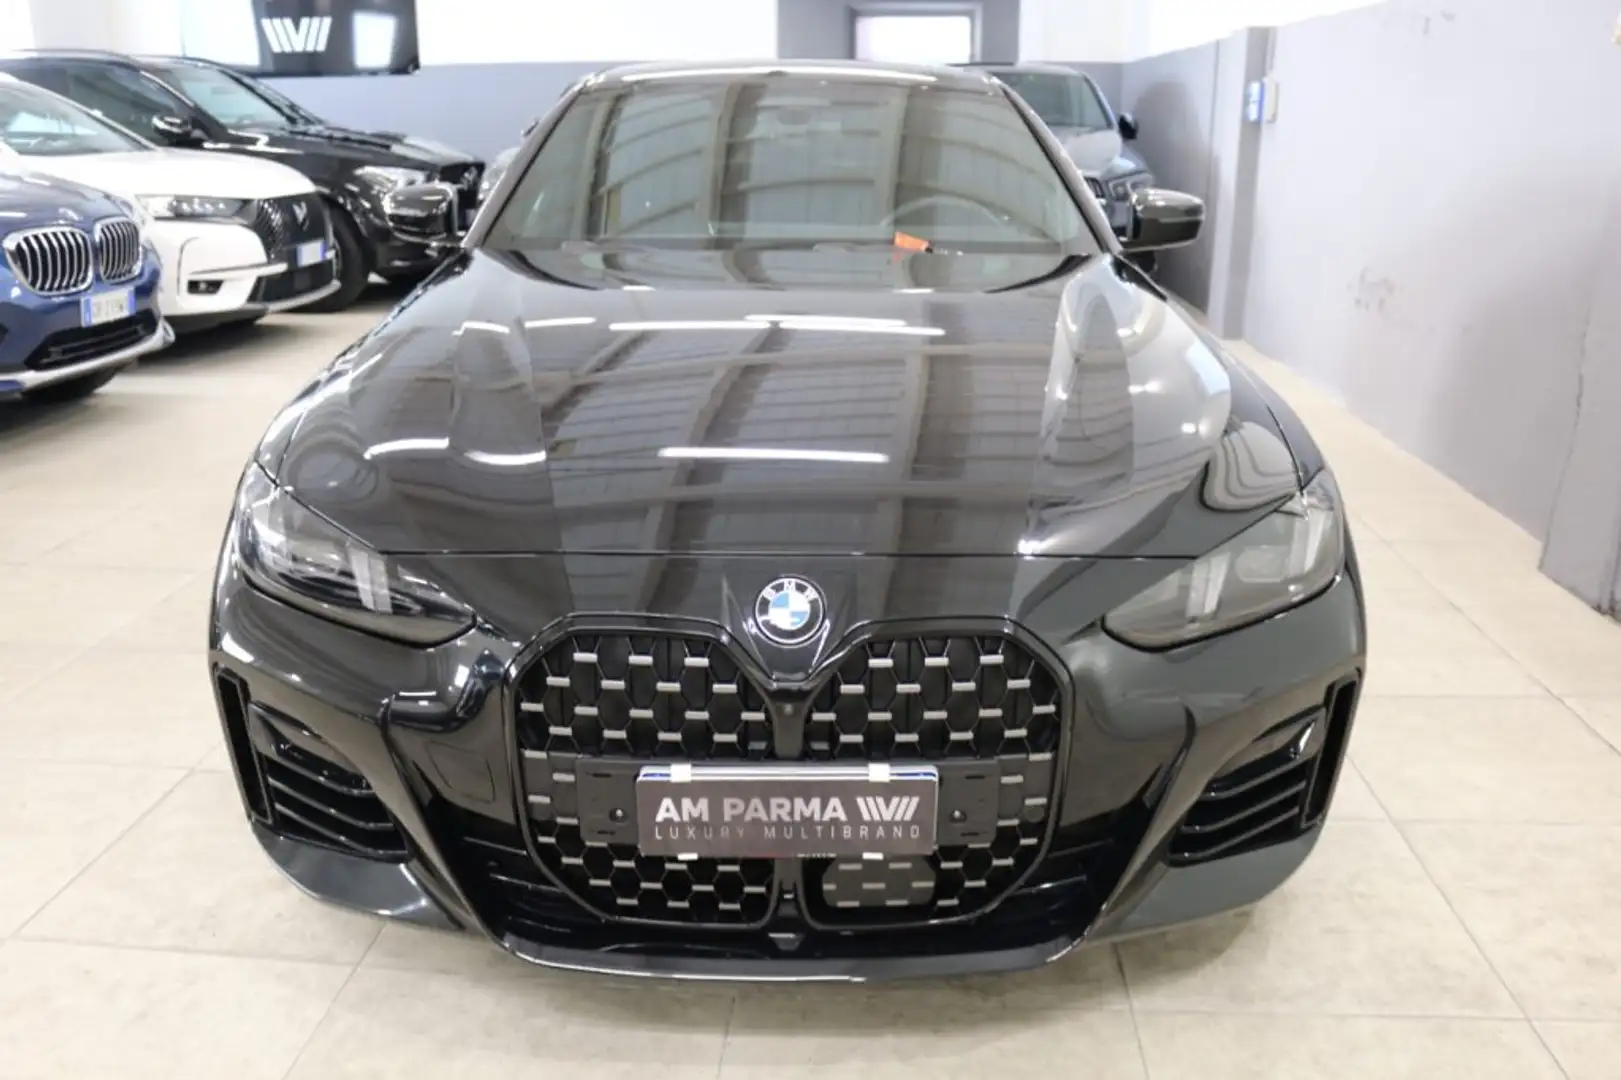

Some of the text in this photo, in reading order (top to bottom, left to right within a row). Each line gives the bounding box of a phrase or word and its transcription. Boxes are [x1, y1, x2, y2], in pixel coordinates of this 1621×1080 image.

[762, 579, 819, 601] BMW
[655, 796, 848, 822] AM PARMA
[655, 825, 921, 839] LUXURY MULTIBRAND
